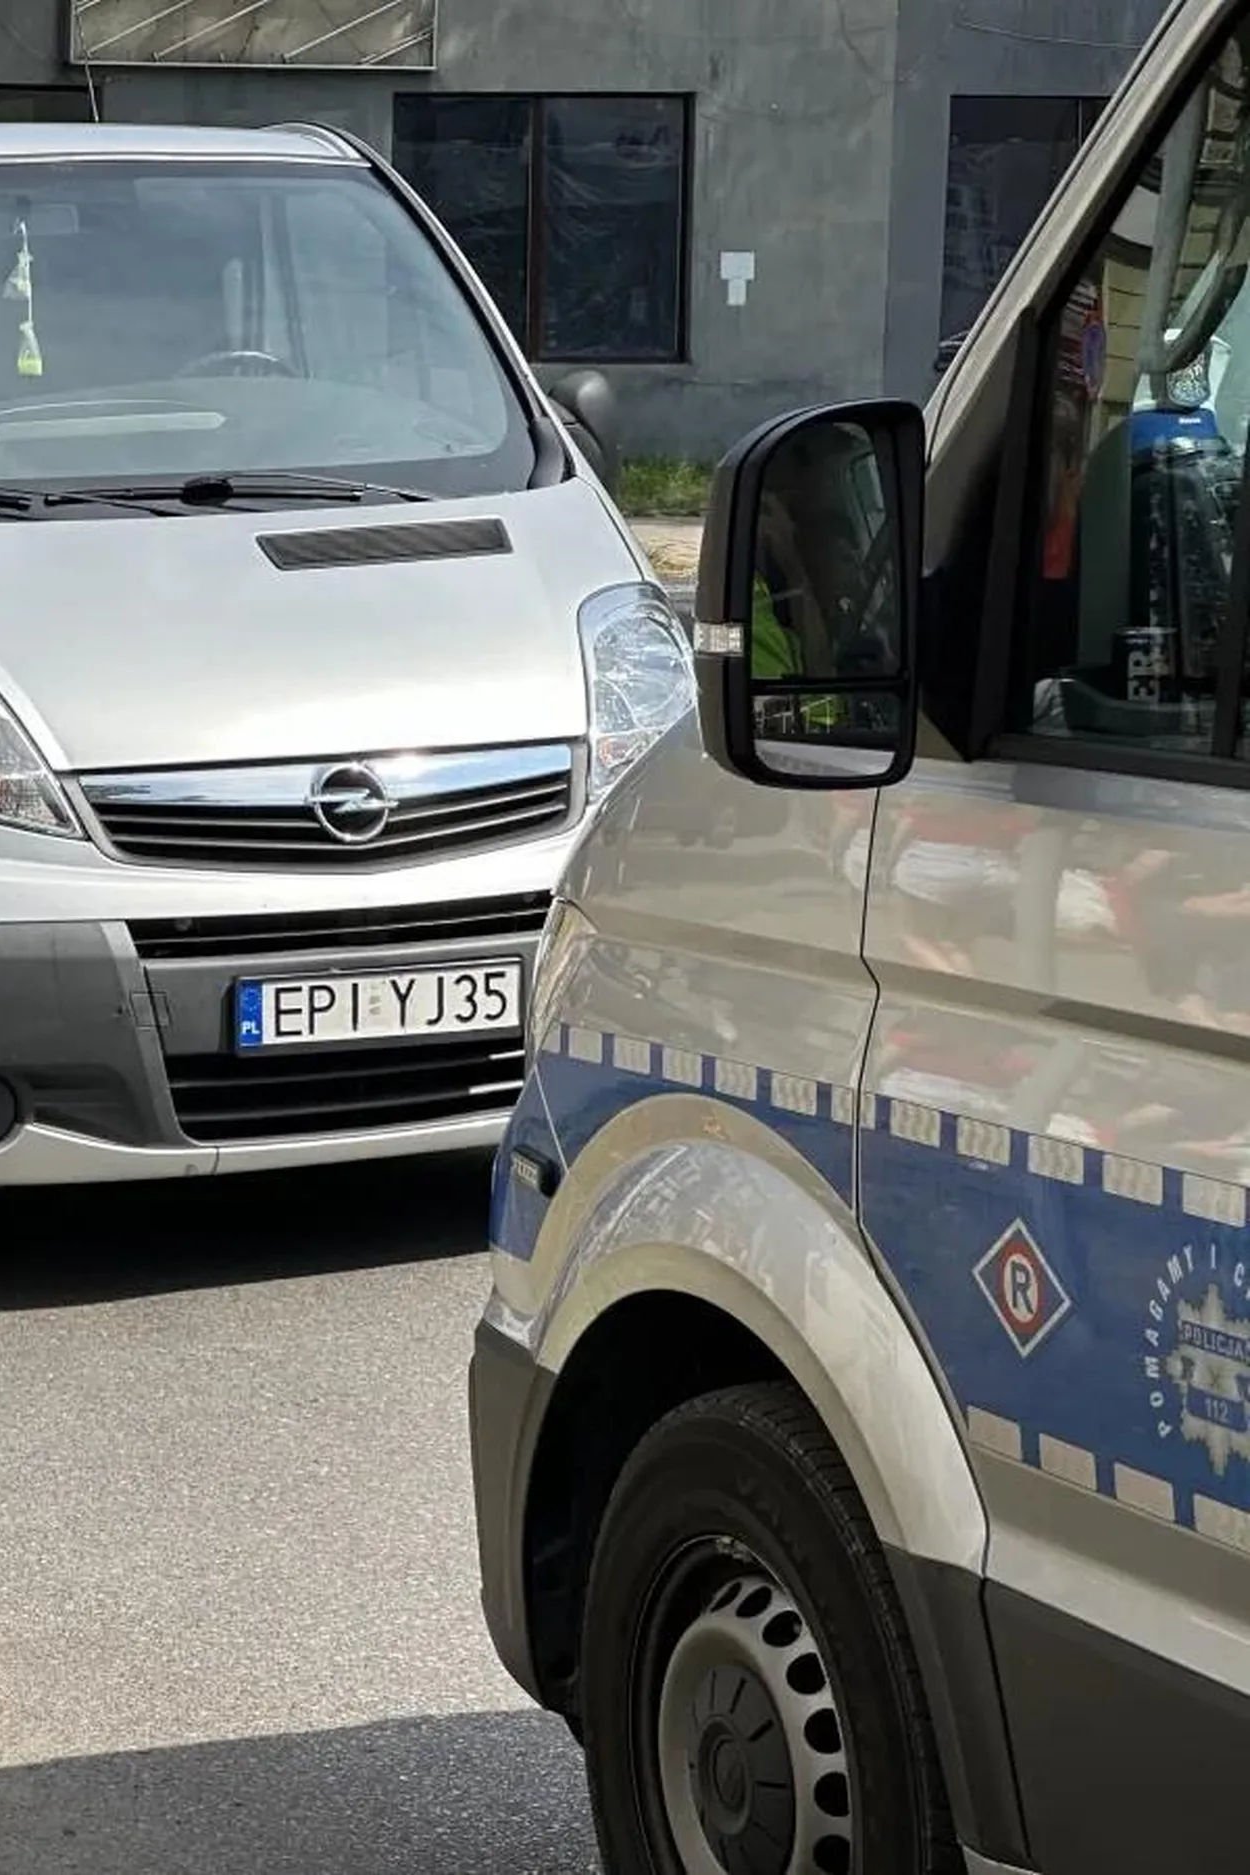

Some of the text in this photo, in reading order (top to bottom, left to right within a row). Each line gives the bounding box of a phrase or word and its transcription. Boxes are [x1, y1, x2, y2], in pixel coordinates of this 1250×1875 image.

[274, 971, 508, 1037] EPI YJ35
[241, 1021, 260, 1035] PL
[1010, 1260, 1034, 1315] R
[1143, 1243, 1194, 1439] POMAGAMY
[1209, 1242, 1217, 1271] I
[1182, 1323, 1244, 1358] POLICJA
[1204, 1396, 1229, 1421] 112
